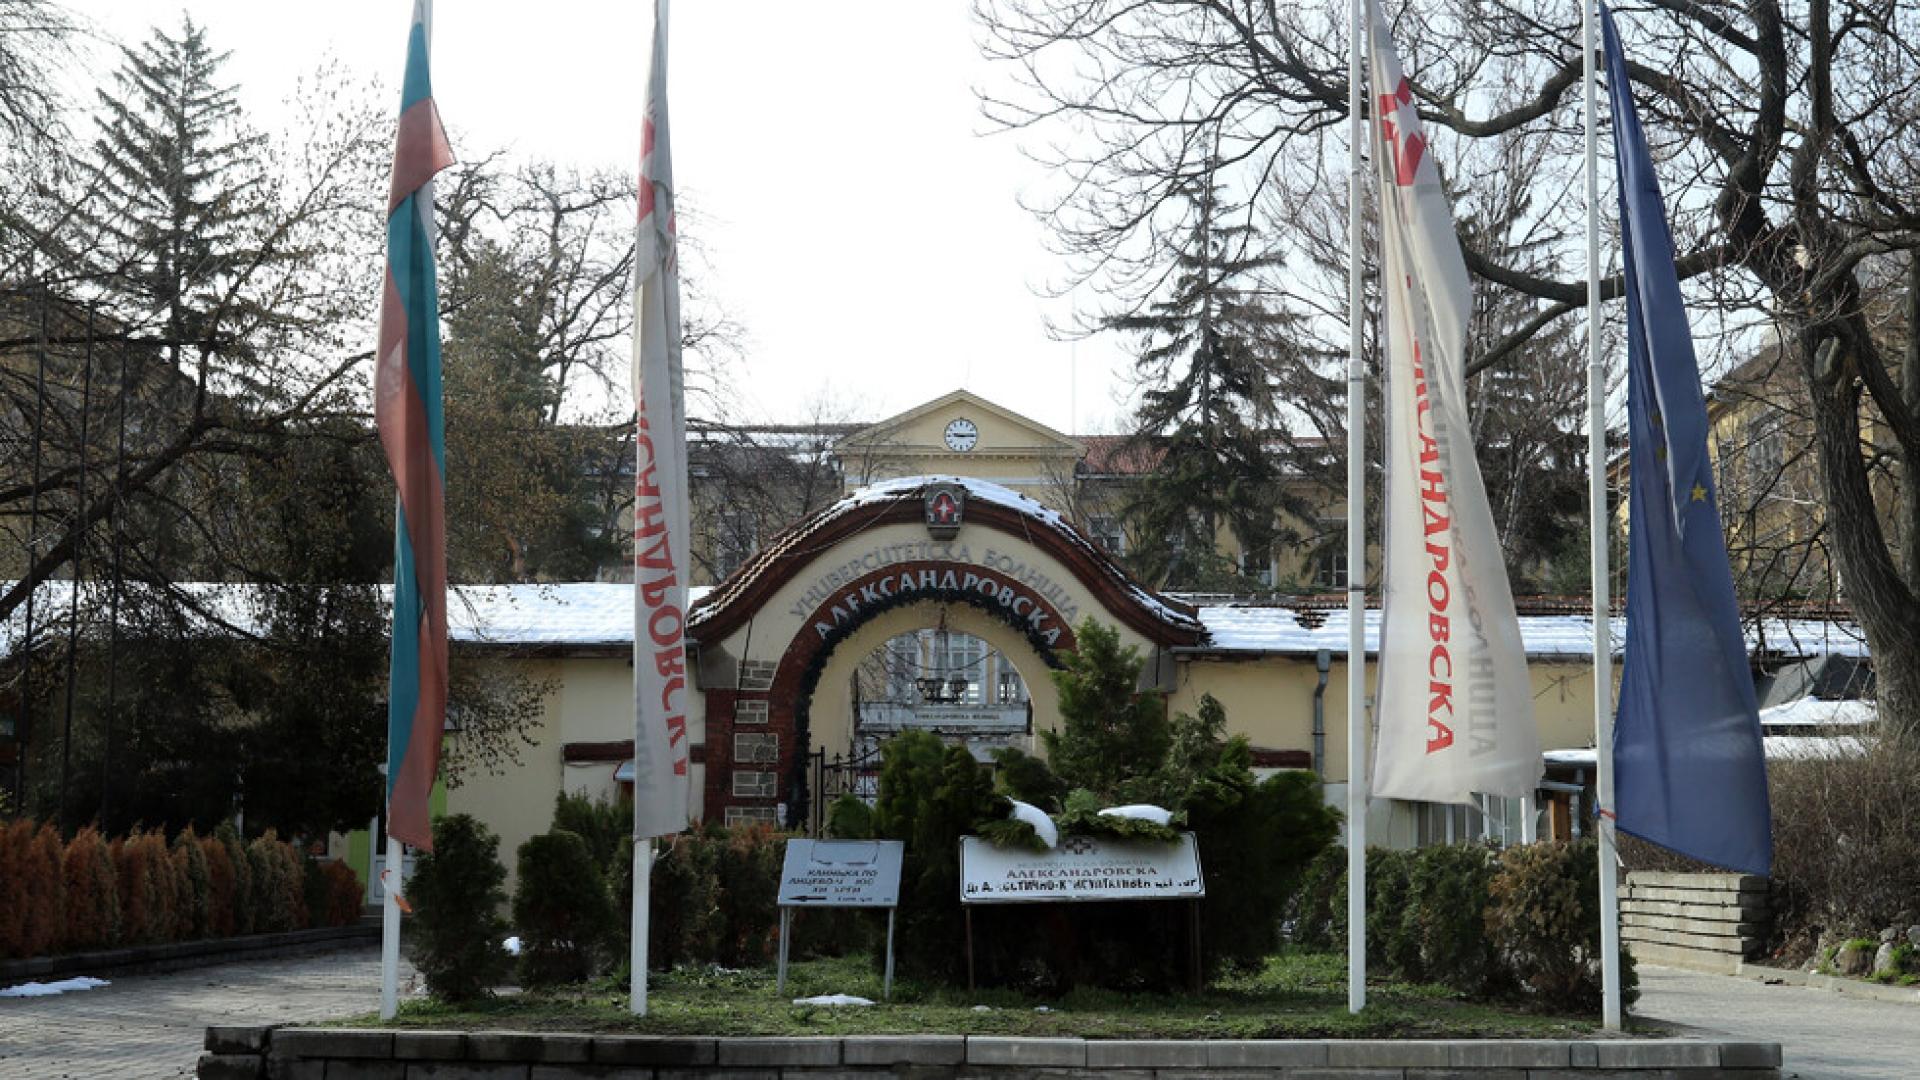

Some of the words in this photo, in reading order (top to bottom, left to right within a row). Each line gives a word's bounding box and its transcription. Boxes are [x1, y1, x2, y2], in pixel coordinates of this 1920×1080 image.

[813, 569, 1062, 645] АЛЕКСАНДРОВСКА
[983, 548, 1080, 624] БОЛНИЦА
[1006, 866, 1159, 879] АЛЕКСАНДРОВСКА
